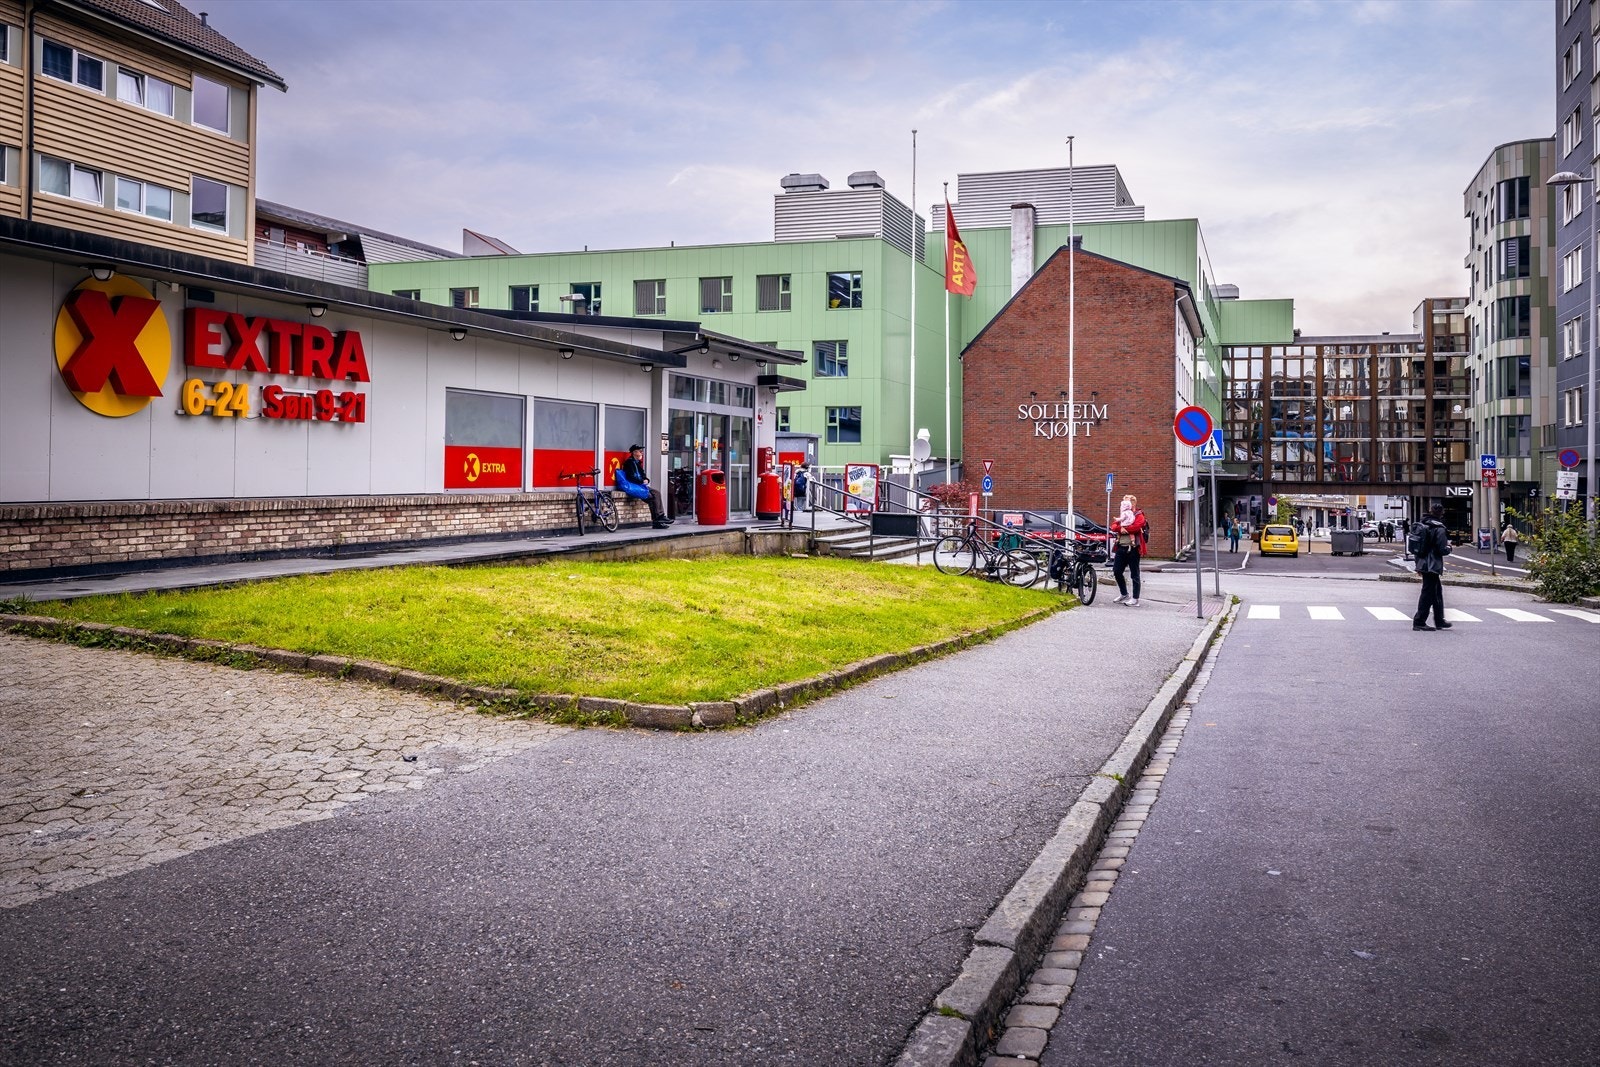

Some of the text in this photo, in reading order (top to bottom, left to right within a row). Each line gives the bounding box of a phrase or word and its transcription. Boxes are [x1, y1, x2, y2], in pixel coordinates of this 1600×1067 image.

[61, 288, 164, 398] X
[184, 307, 371, 383] EXTRA
[182, 378, 250, 418] 6-24
[262, 384, 366, 423] Søn 9-21
[1018, 403, 1109, 420] SOLHEIM
[1034, 421, 1095, 440] KJØTT
[482, 462, 506, 474] EXTRA
